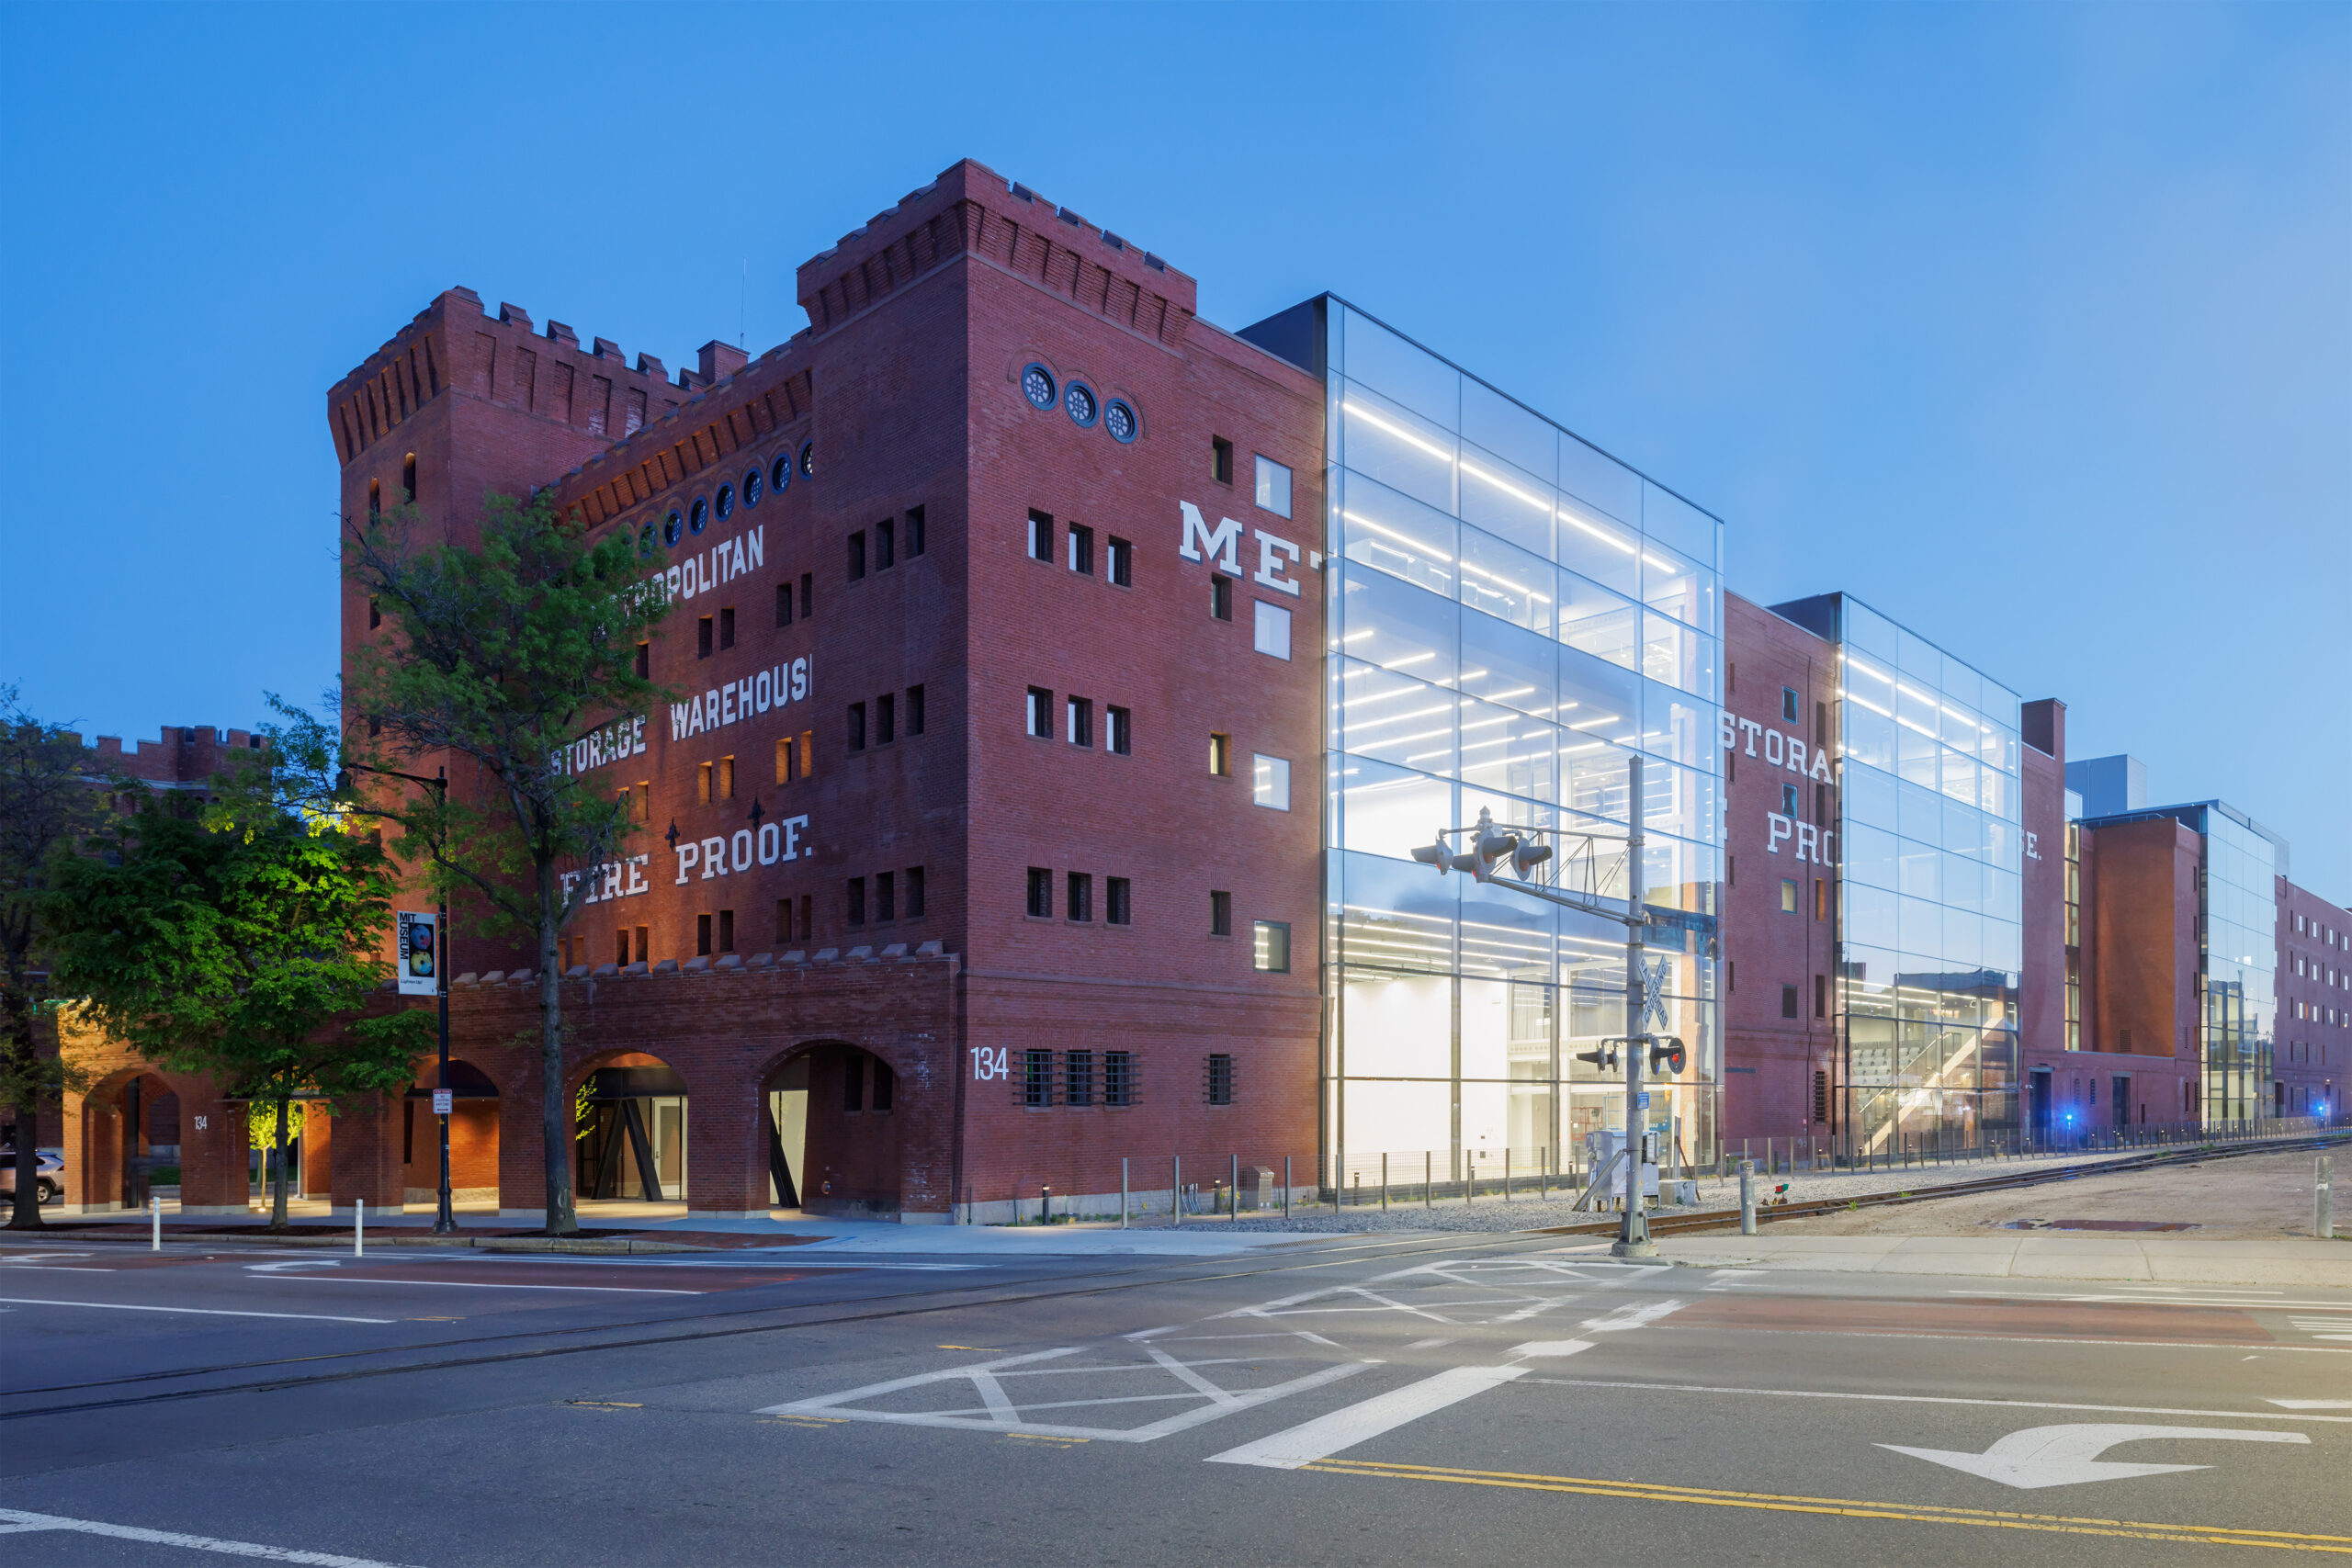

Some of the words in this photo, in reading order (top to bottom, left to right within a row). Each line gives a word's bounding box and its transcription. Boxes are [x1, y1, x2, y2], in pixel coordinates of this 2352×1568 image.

[551, 715, 646, 776] STORAGE
[671, 653, 812, 742] WAREHOUS
[560, 853, 649, 908] FIRE
[675, 814, 812, 886] PROOF.
[399, 912, 416, 922] MIT
[1644, 964, 1667, 1023] CROSSING
[970, 1046, 1009, 1080] 134
[194, 1116, 208, 1130] 134
